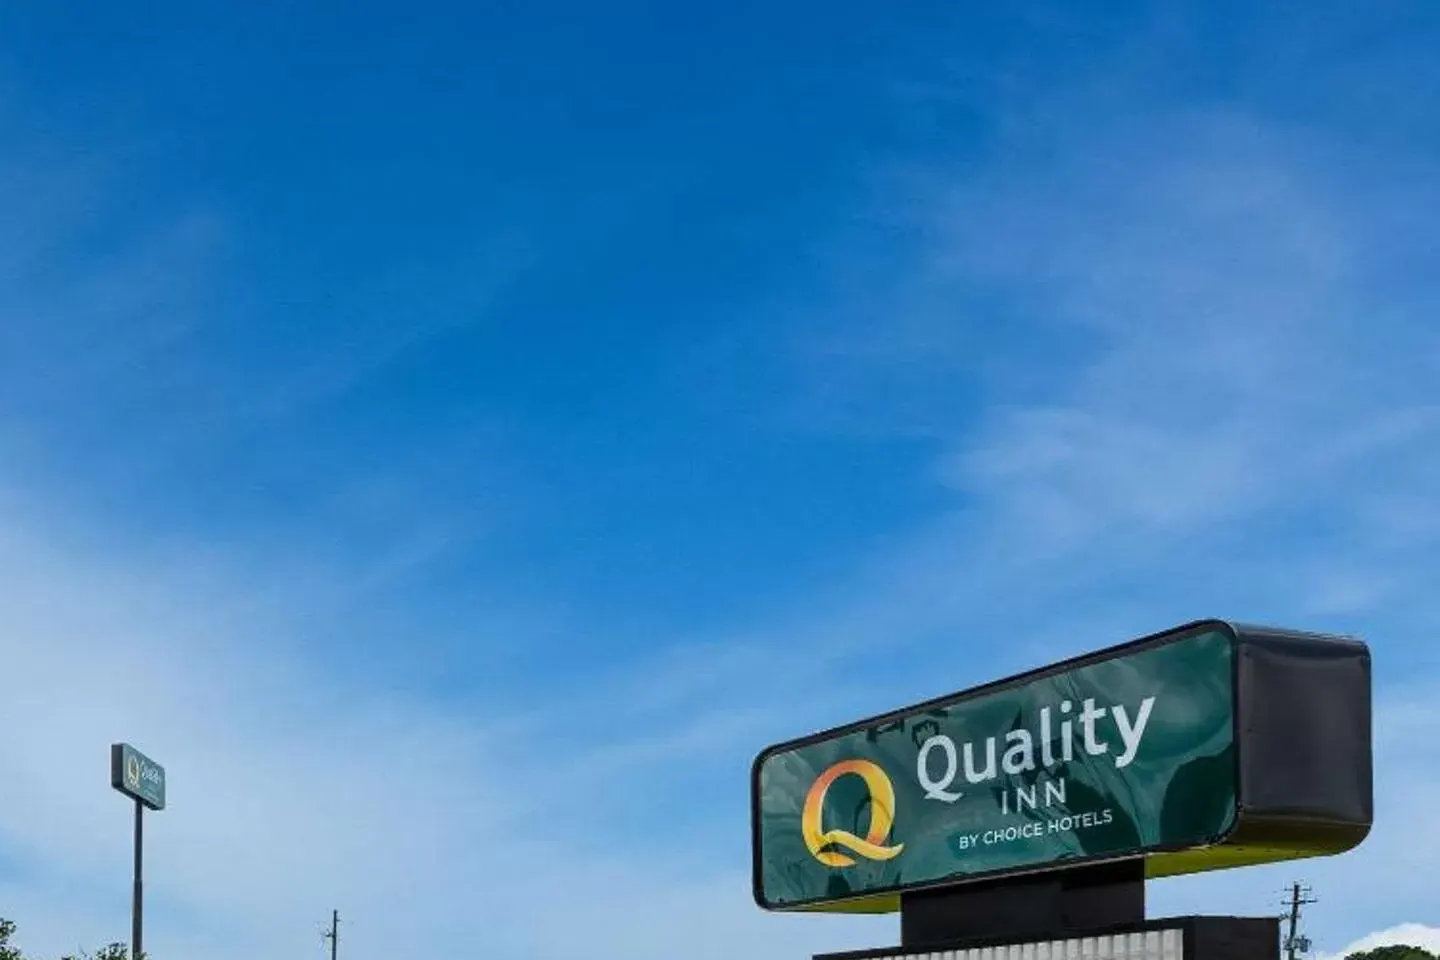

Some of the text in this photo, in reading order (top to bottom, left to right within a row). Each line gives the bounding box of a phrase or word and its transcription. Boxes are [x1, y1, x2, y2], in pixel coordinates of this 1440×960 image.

[917, 696, 1155, 802] Quality
[802, 759, 904, 867] Q
[959, 809, 1113, 850] BY CHOICE HOTELS
[1002, 778, 1066, 815] INN
